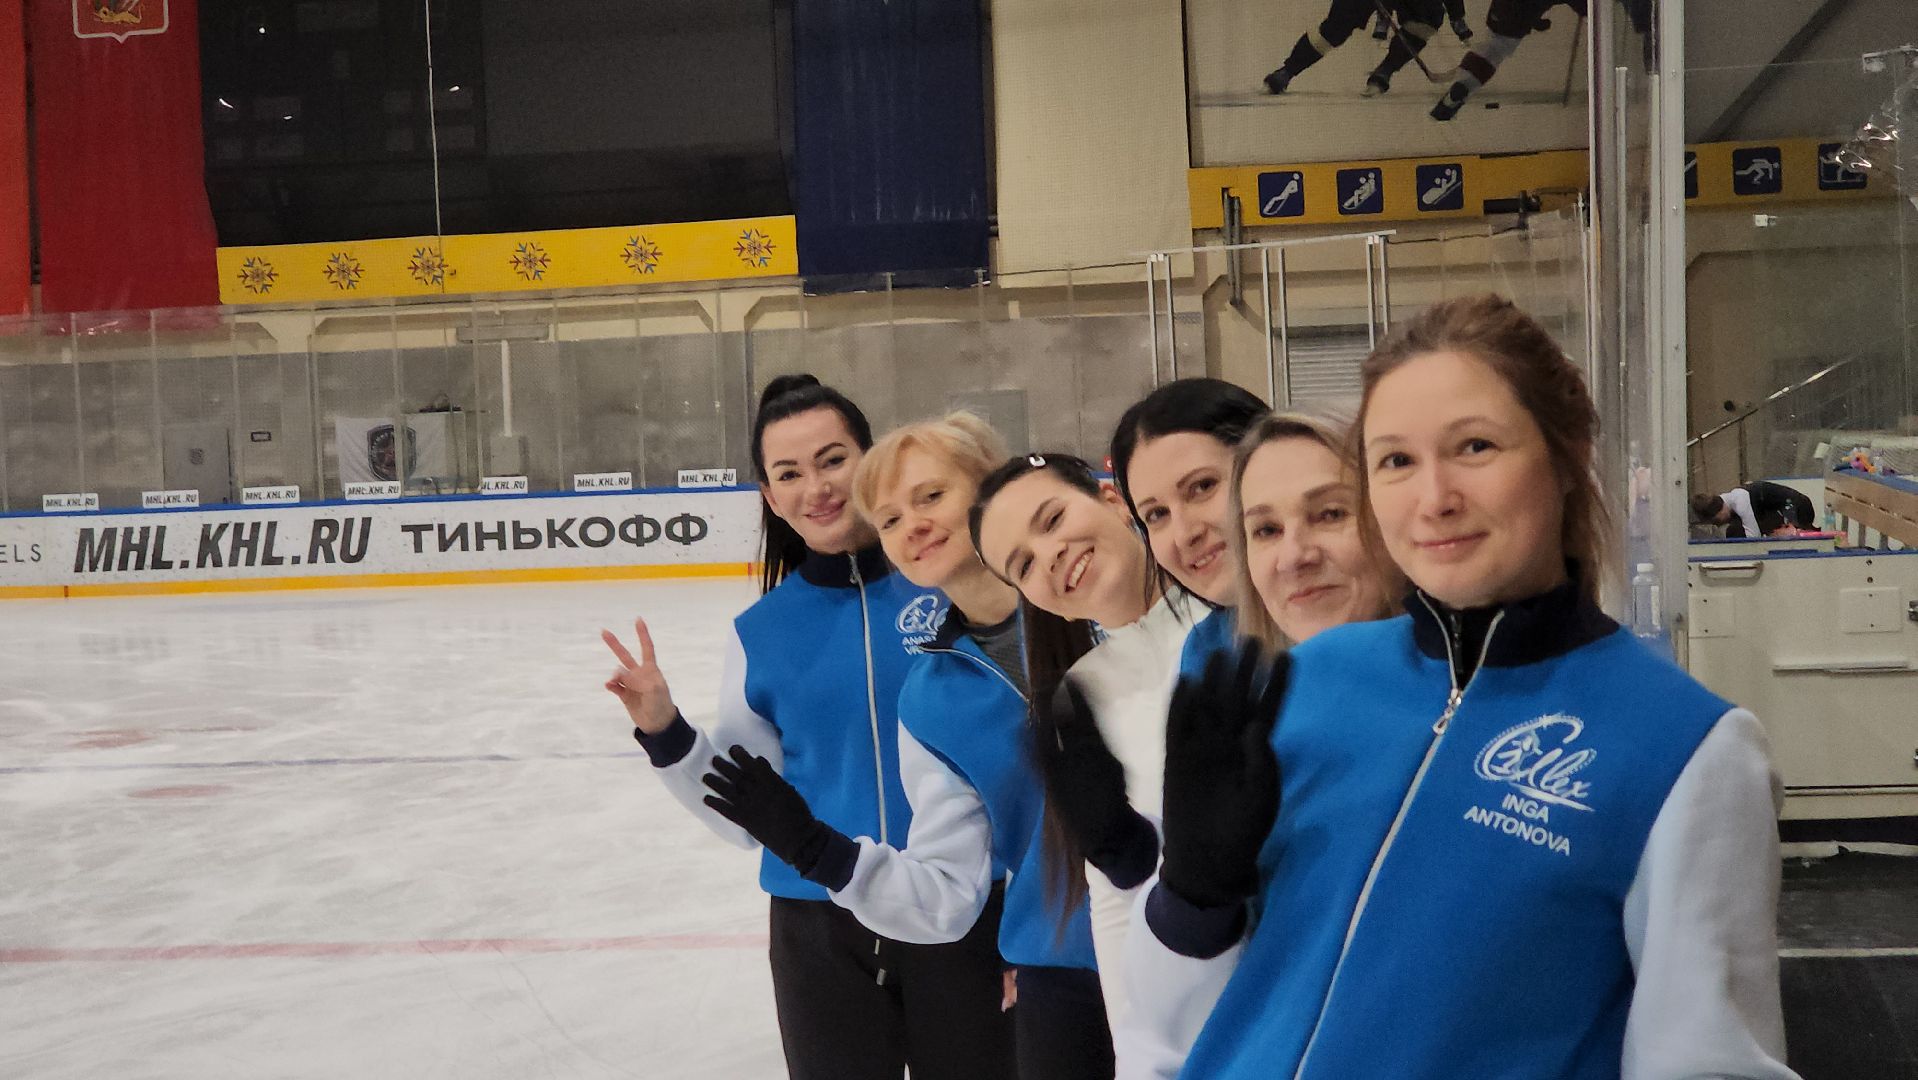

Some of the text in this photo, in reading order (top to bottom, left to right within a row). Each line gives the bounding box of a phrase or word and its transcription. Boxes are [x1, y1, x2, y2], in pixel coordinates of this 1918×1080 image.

[481, 480, 526, 490] L.KHL.RU
[577, 478, 630, 488] MHL.KHL.RU
[73, 516, 373, 573] MHL.KHL.RU
[400, 512, 708, 553] ТИНЬКОФФ
[1502, 793, 1549, 824] INGA
[1463, 805, 1571, 857] ANTONOVA
